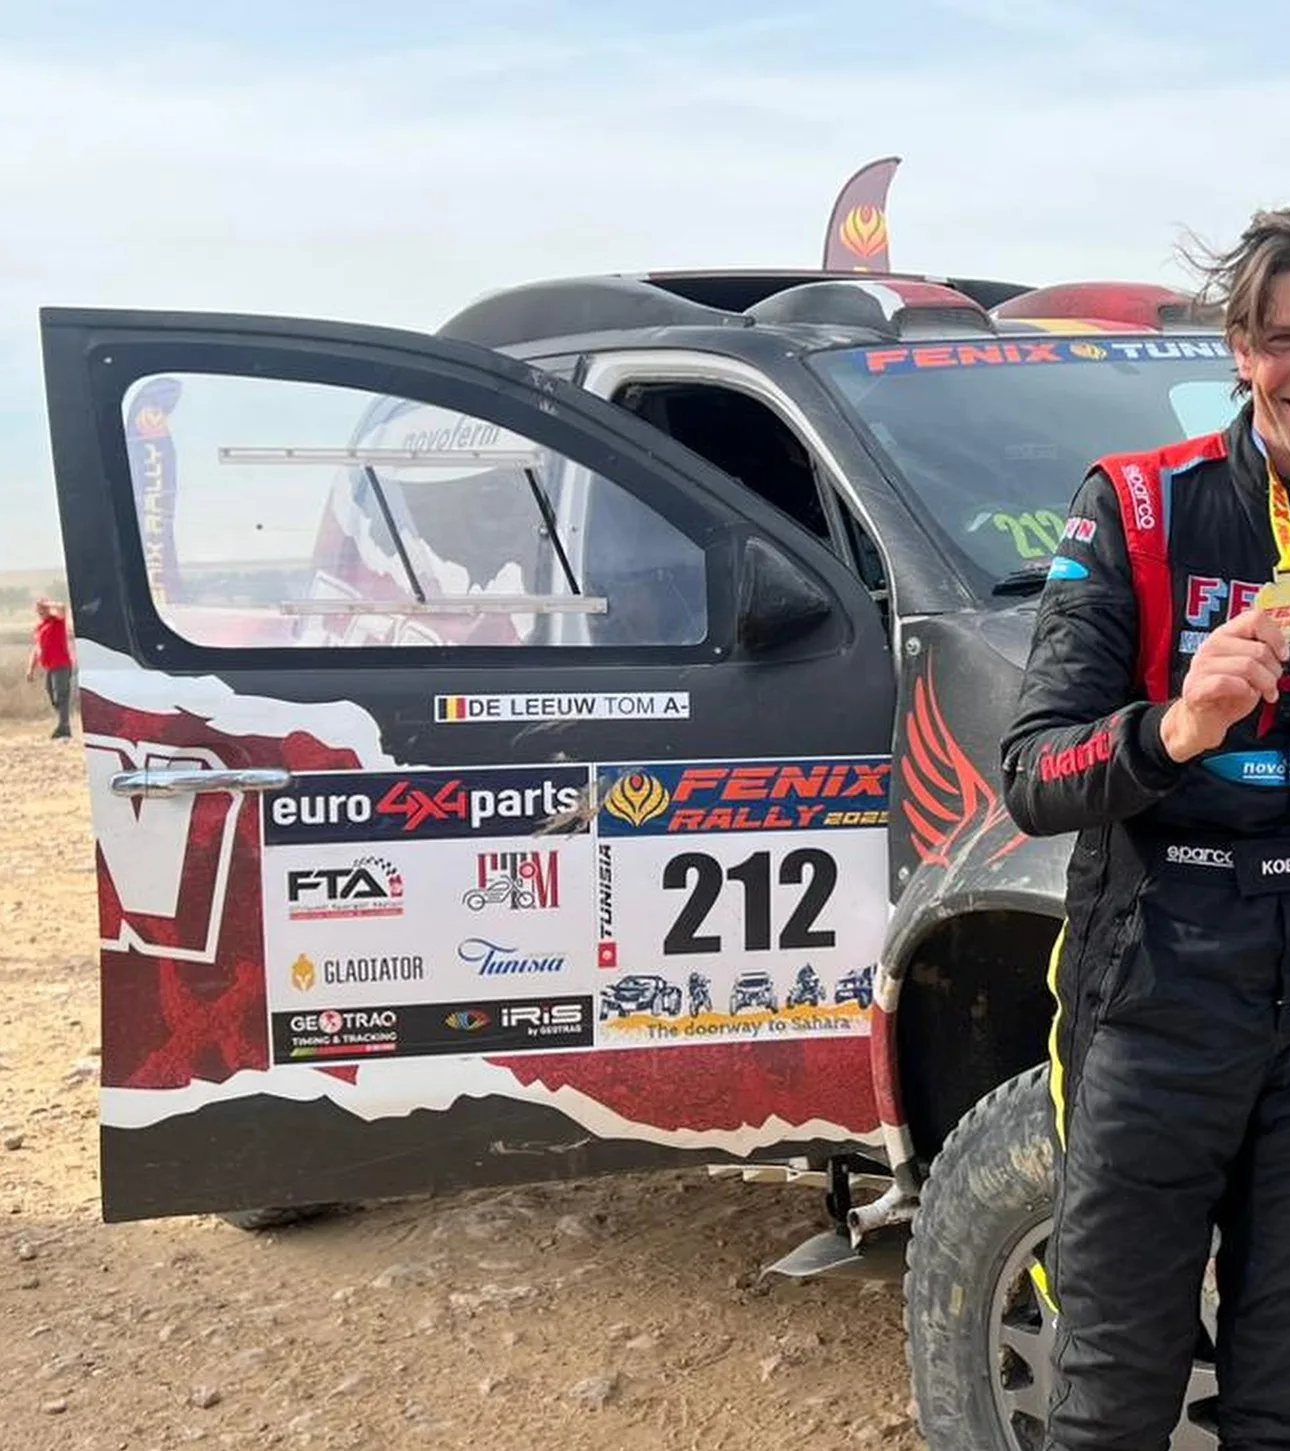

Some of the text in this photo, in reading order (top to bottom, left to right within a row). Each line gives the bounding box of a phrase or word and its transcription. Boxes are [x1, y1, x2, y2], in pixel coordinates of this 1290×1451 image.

[865, 340, 1228, 375] FENIX TUNI
[1121, 465, 1155, 531] sparco
[468, 698, 501, 717] DE
[510, 697, 597, 716] LEEUW
[604, 696, 656, 715] TOM
[671, 763, 892, 803] FENIX
[668, 804, 826, 832] RALLY
[287, 867, 389, 902] FTA
[599, 843, 612, 940] TUNISIA
[662, 847, 838, 956] 212
[324, 956, 424, 984] GLADIATOR
[457, 937, 565, 976] Tunisia
[292, 1035, 331, 1046] TIMING
[342, 1032, 398, 1044] TRACKING
[528, 1027, 539, 1037] by
[648, 1014, 851, 1039] The doorway to Sahara
